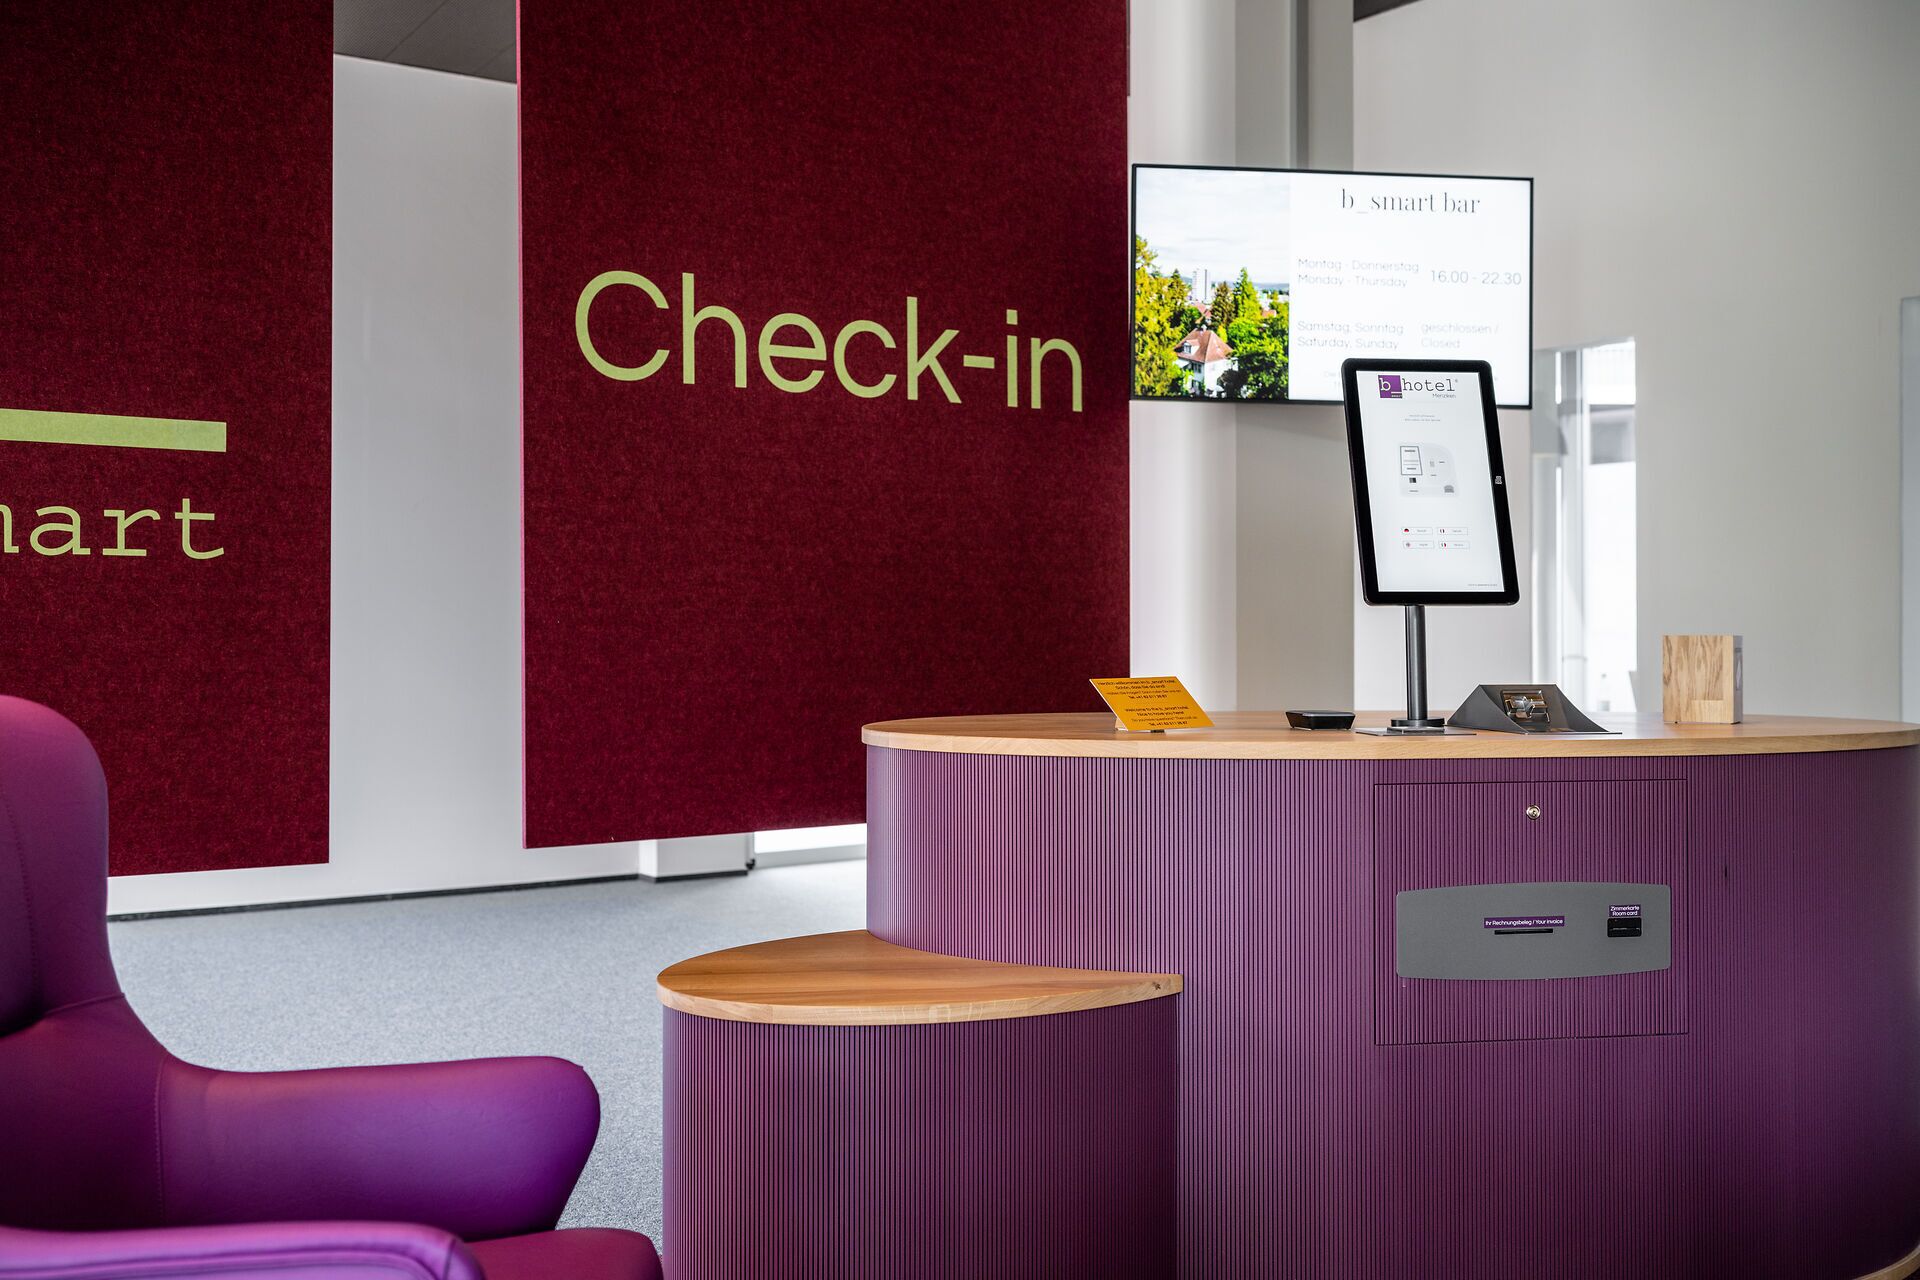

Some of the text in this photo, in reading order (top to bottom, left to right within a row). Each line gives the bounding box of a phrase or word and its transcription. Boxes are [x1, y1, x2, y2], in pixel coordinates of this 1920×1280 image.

[1341, 187, 1481, 214] b_smart bar
[1297, 257, 1342, 271] Montag
[1352, 259, 1420, 273] Donnerstag
[1297, 273, 1344, 286] Monday
[1355, 274, 1408, 288] Thursday
[1431, 269, 1469, 284] 16.00
[1481, 271, 1522, 286] 22.30
[1355, 322, 1405, 335] Sonntag
[1421, 321, 1493, 335] geschlossen
[575, 270, 1083, 413] Check-in
[1355, 337, 1399, 350] Sunday
[1421, 337, 1460, 349] Closed
[0, 498, 225, 560] art
